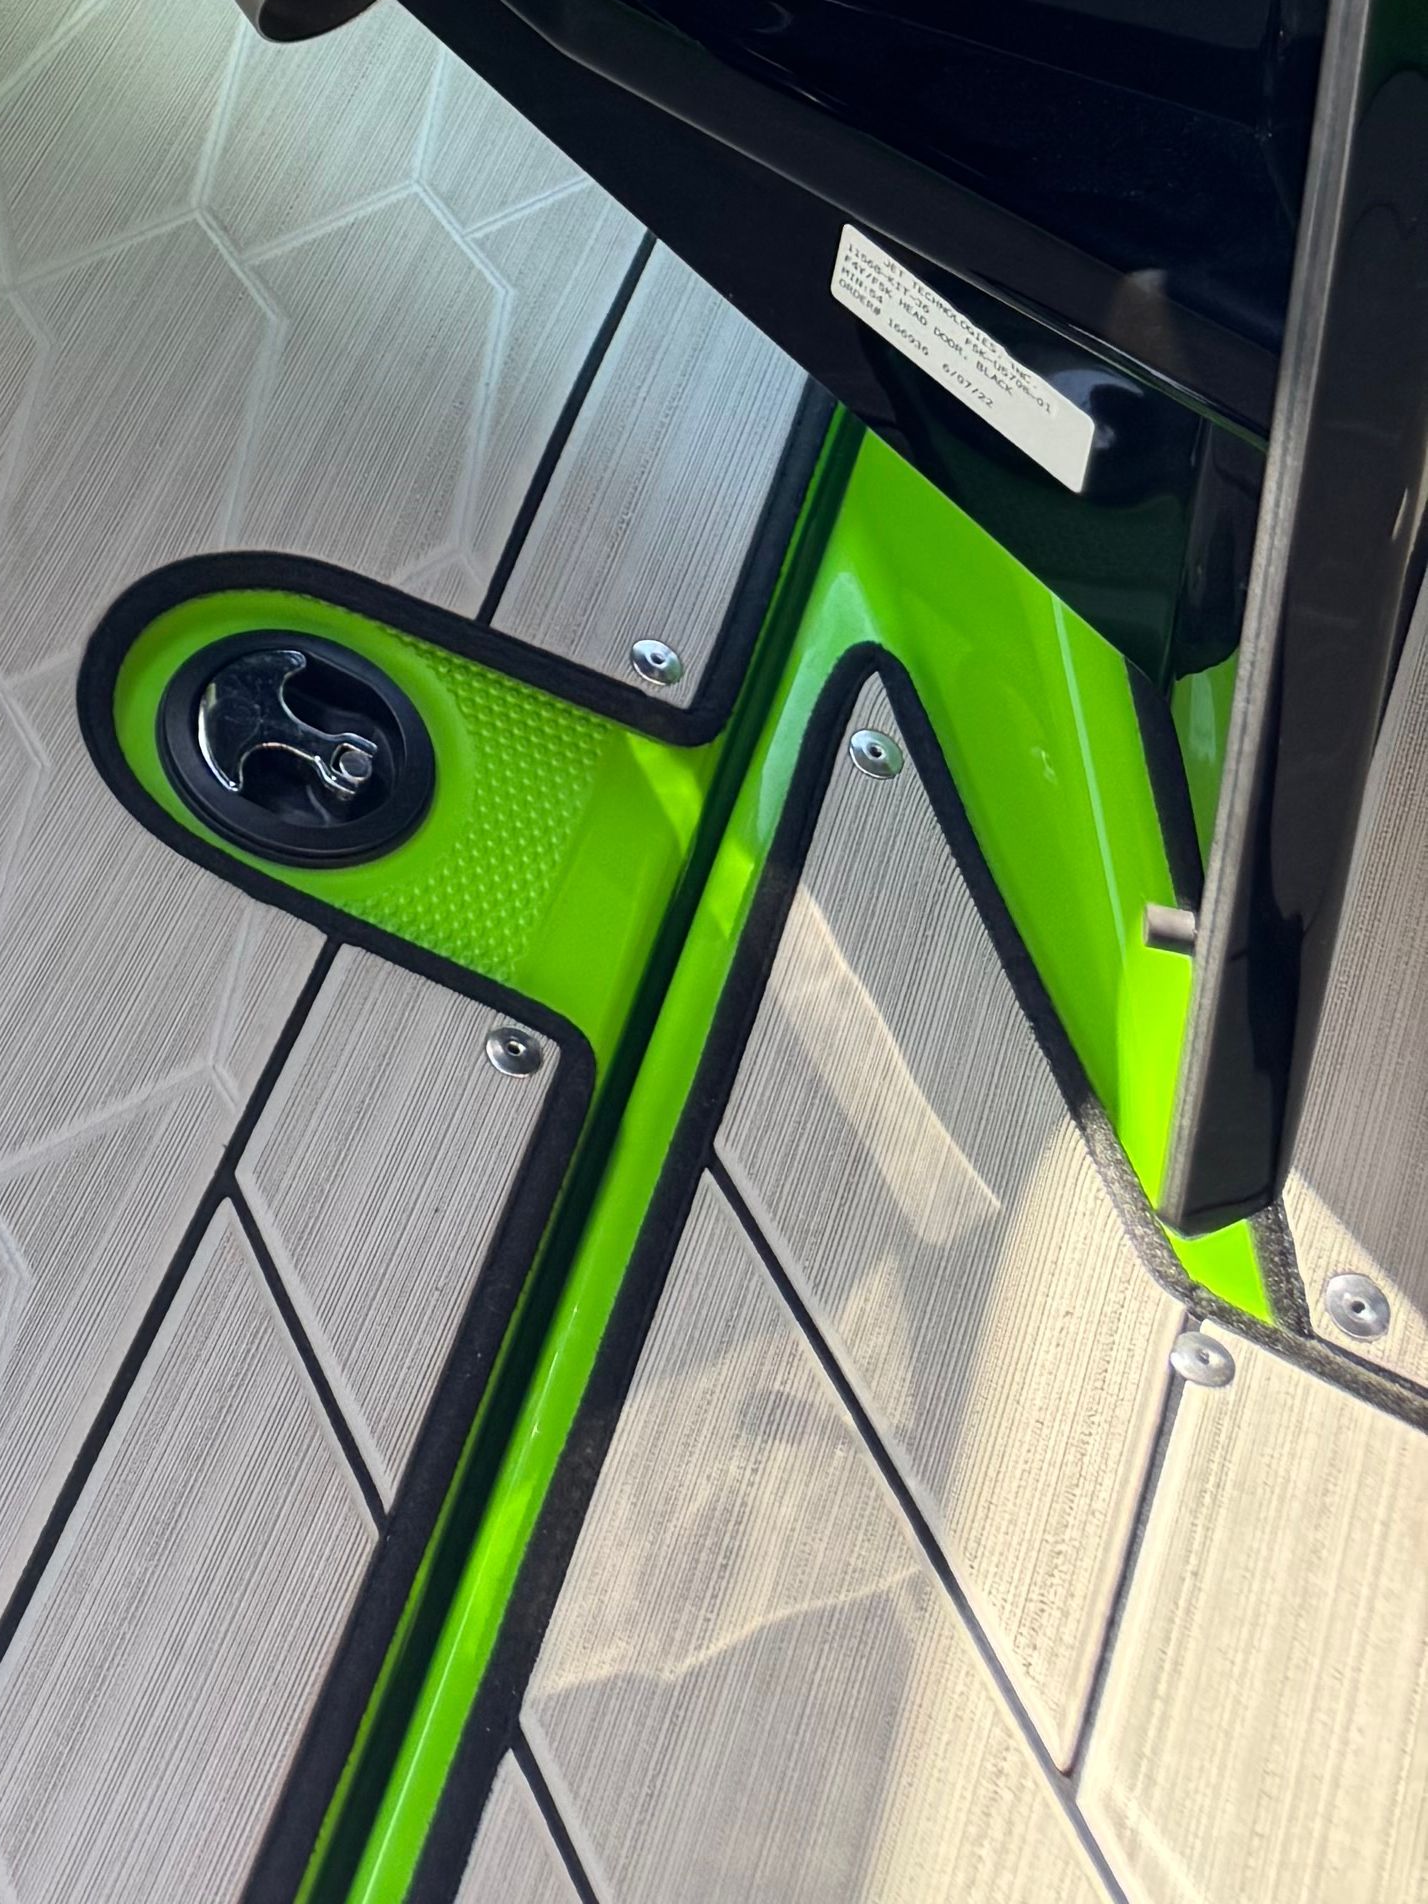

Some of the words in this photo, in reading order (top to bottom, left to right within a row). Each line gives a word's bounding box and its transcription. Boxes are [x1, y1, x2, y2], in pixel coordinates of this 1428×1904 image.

[882, 256, 904, 279] JET
[898, 297, 928, 328] HEAD
[975, 359, 1014, 397] BLACK
